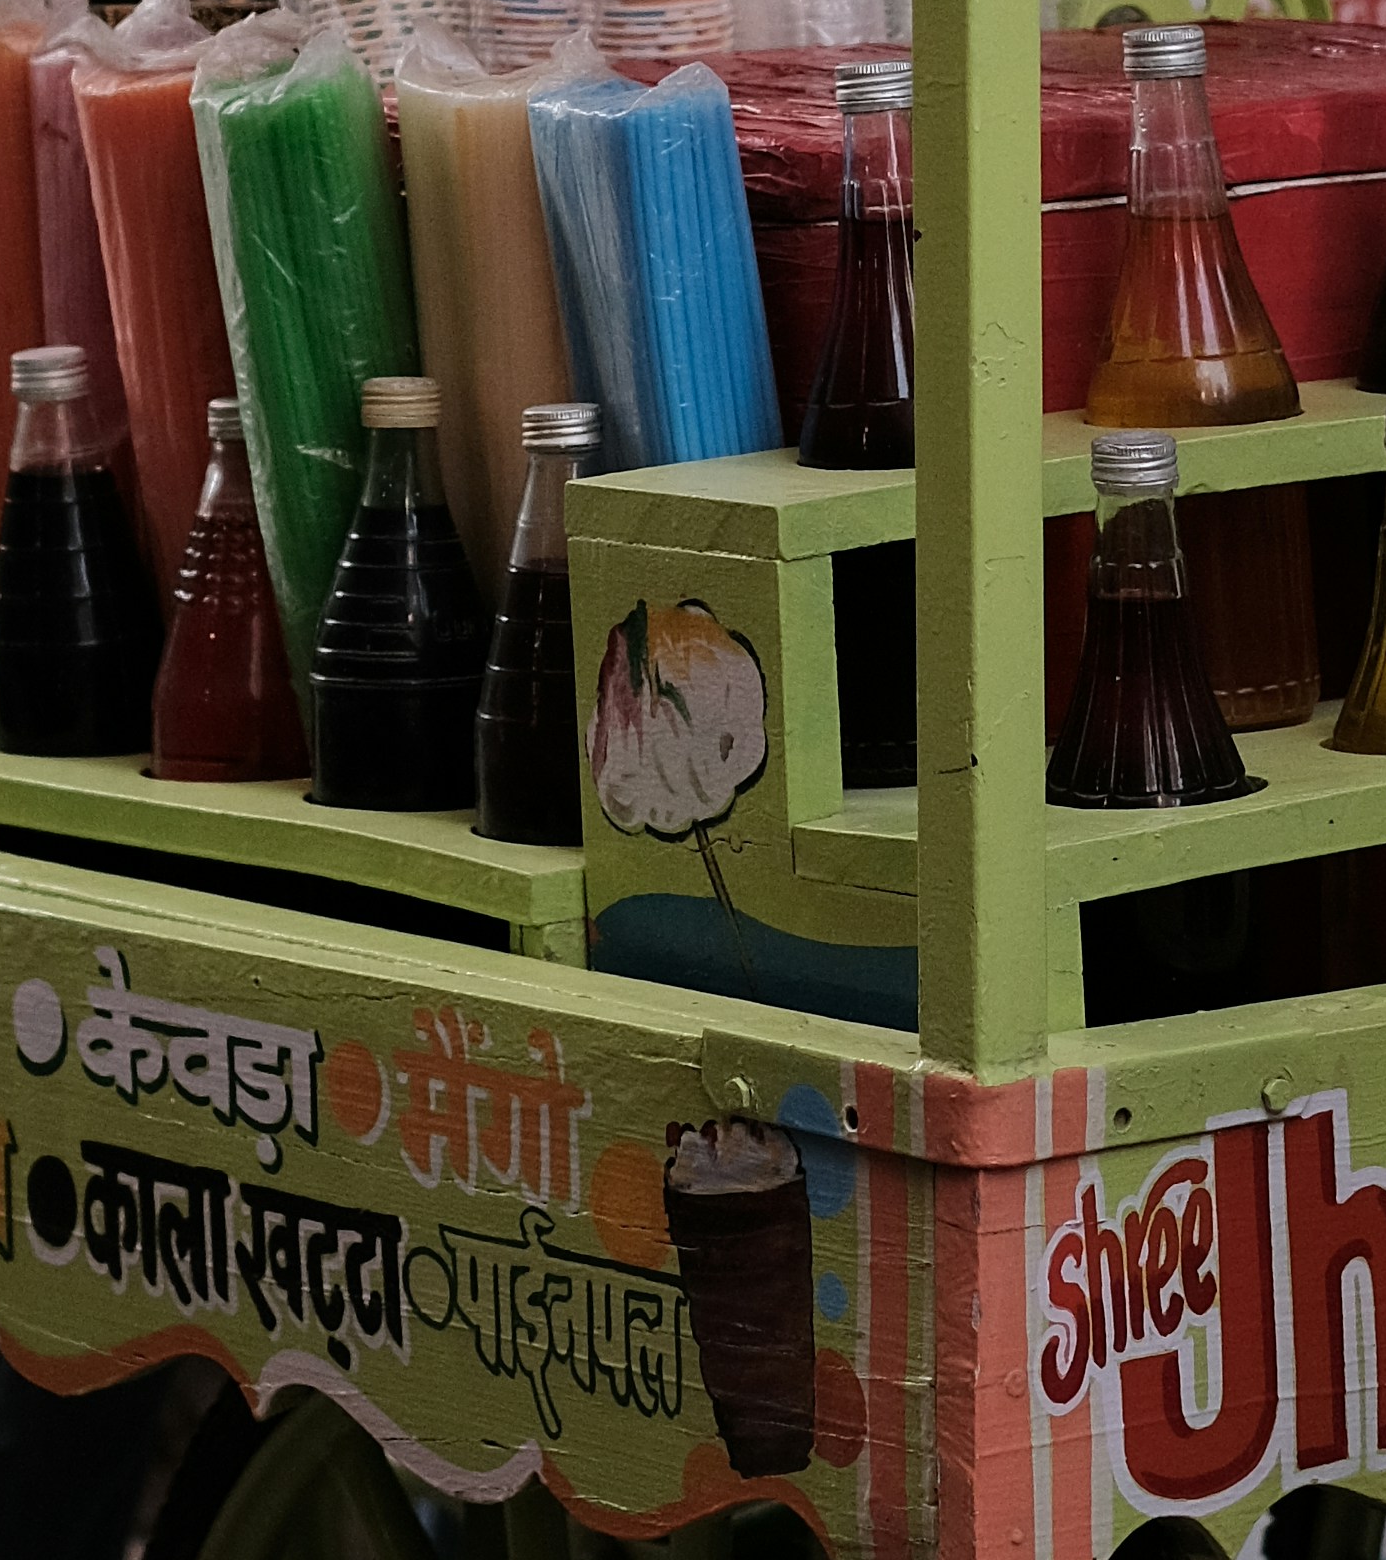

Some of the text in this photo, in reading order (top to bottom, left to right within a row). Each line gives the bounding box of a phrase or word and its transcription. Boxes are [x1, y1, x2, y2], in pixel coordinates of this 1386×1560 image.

[76, 945, 324, 1175] केवड़ा
[80, 1140, 232, 1306] काला
[235, 1181, 403, 1371] खट्टा
